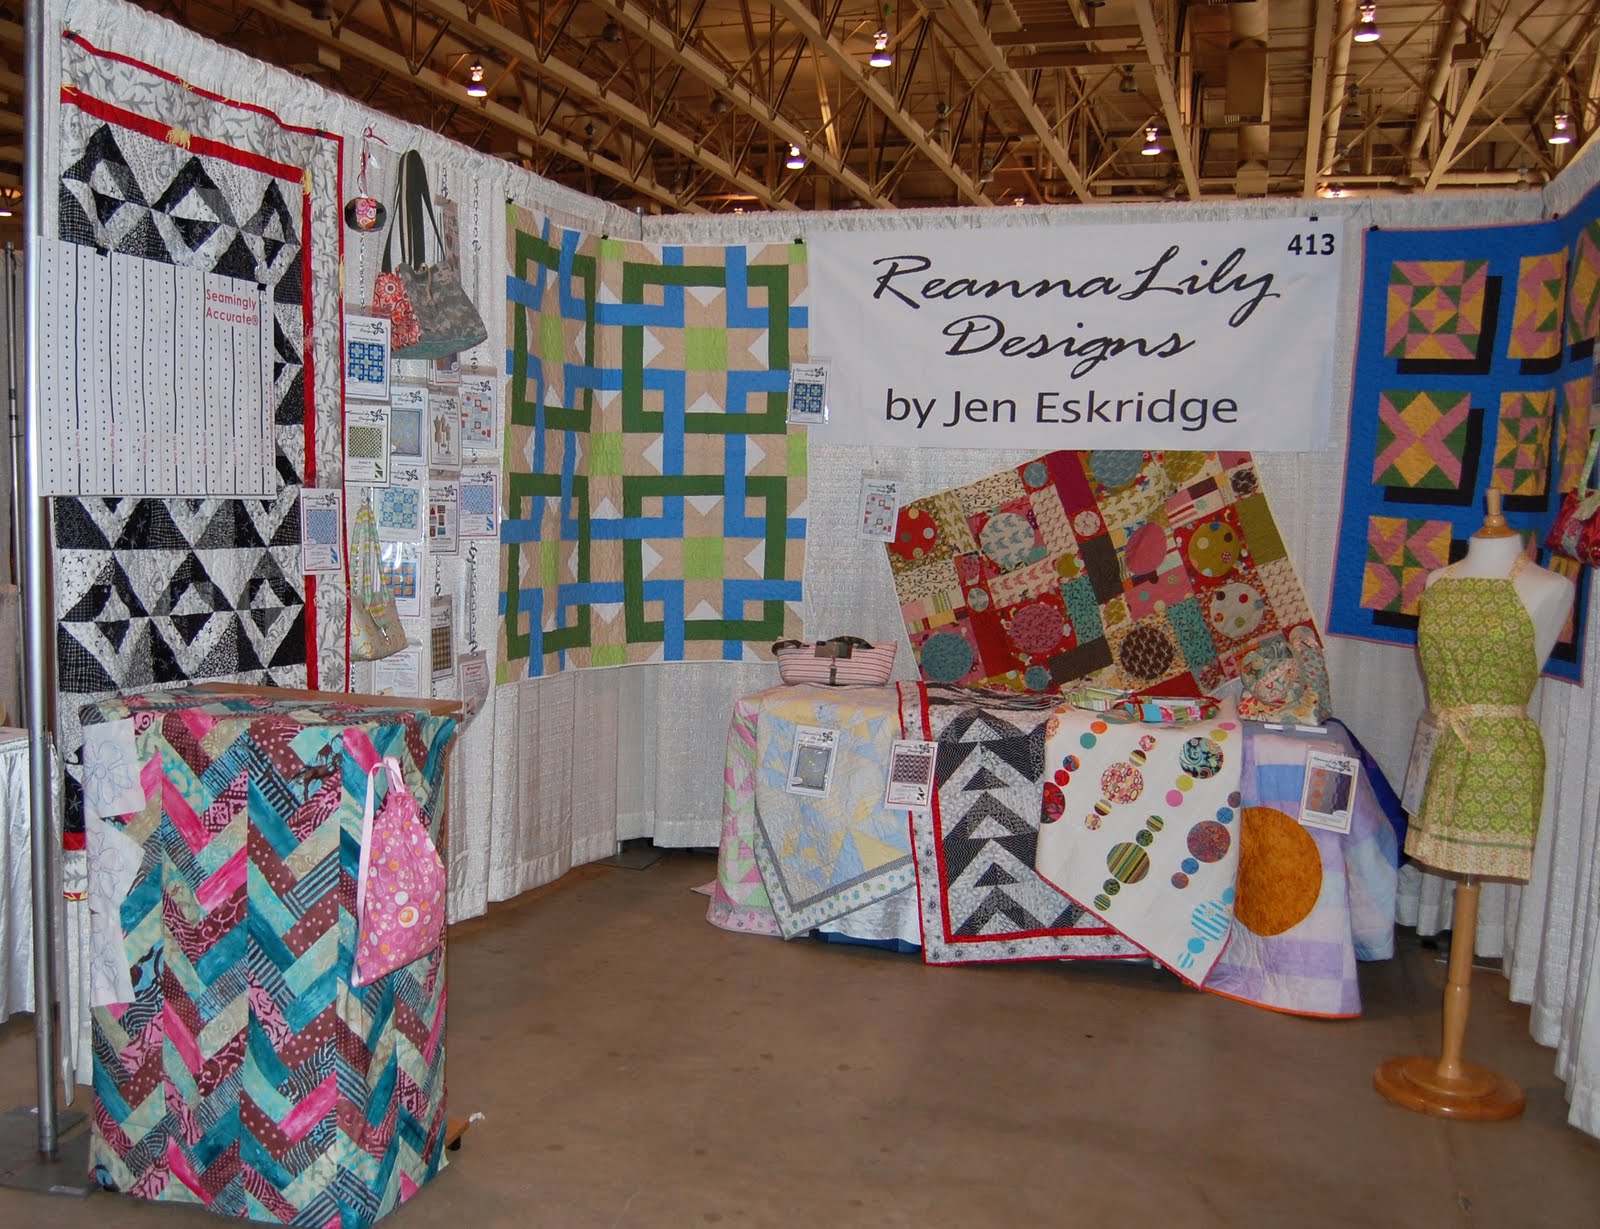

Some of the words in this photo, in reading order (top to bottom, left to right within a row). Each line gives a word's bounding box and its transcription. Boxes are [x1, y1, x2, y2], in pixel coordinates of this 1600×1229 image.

[1287, 233, 1335, 257] 413
[206, 288, 257, 311] Seamingly
[872, 244, 1281, 328] ReannaLily
[941, 313, 1196, 379] Designs
[885, 388, 937, 428] by
[943, 390, 1016, 428] Jen
[1036, 388, 1239, 432] Eskridge
